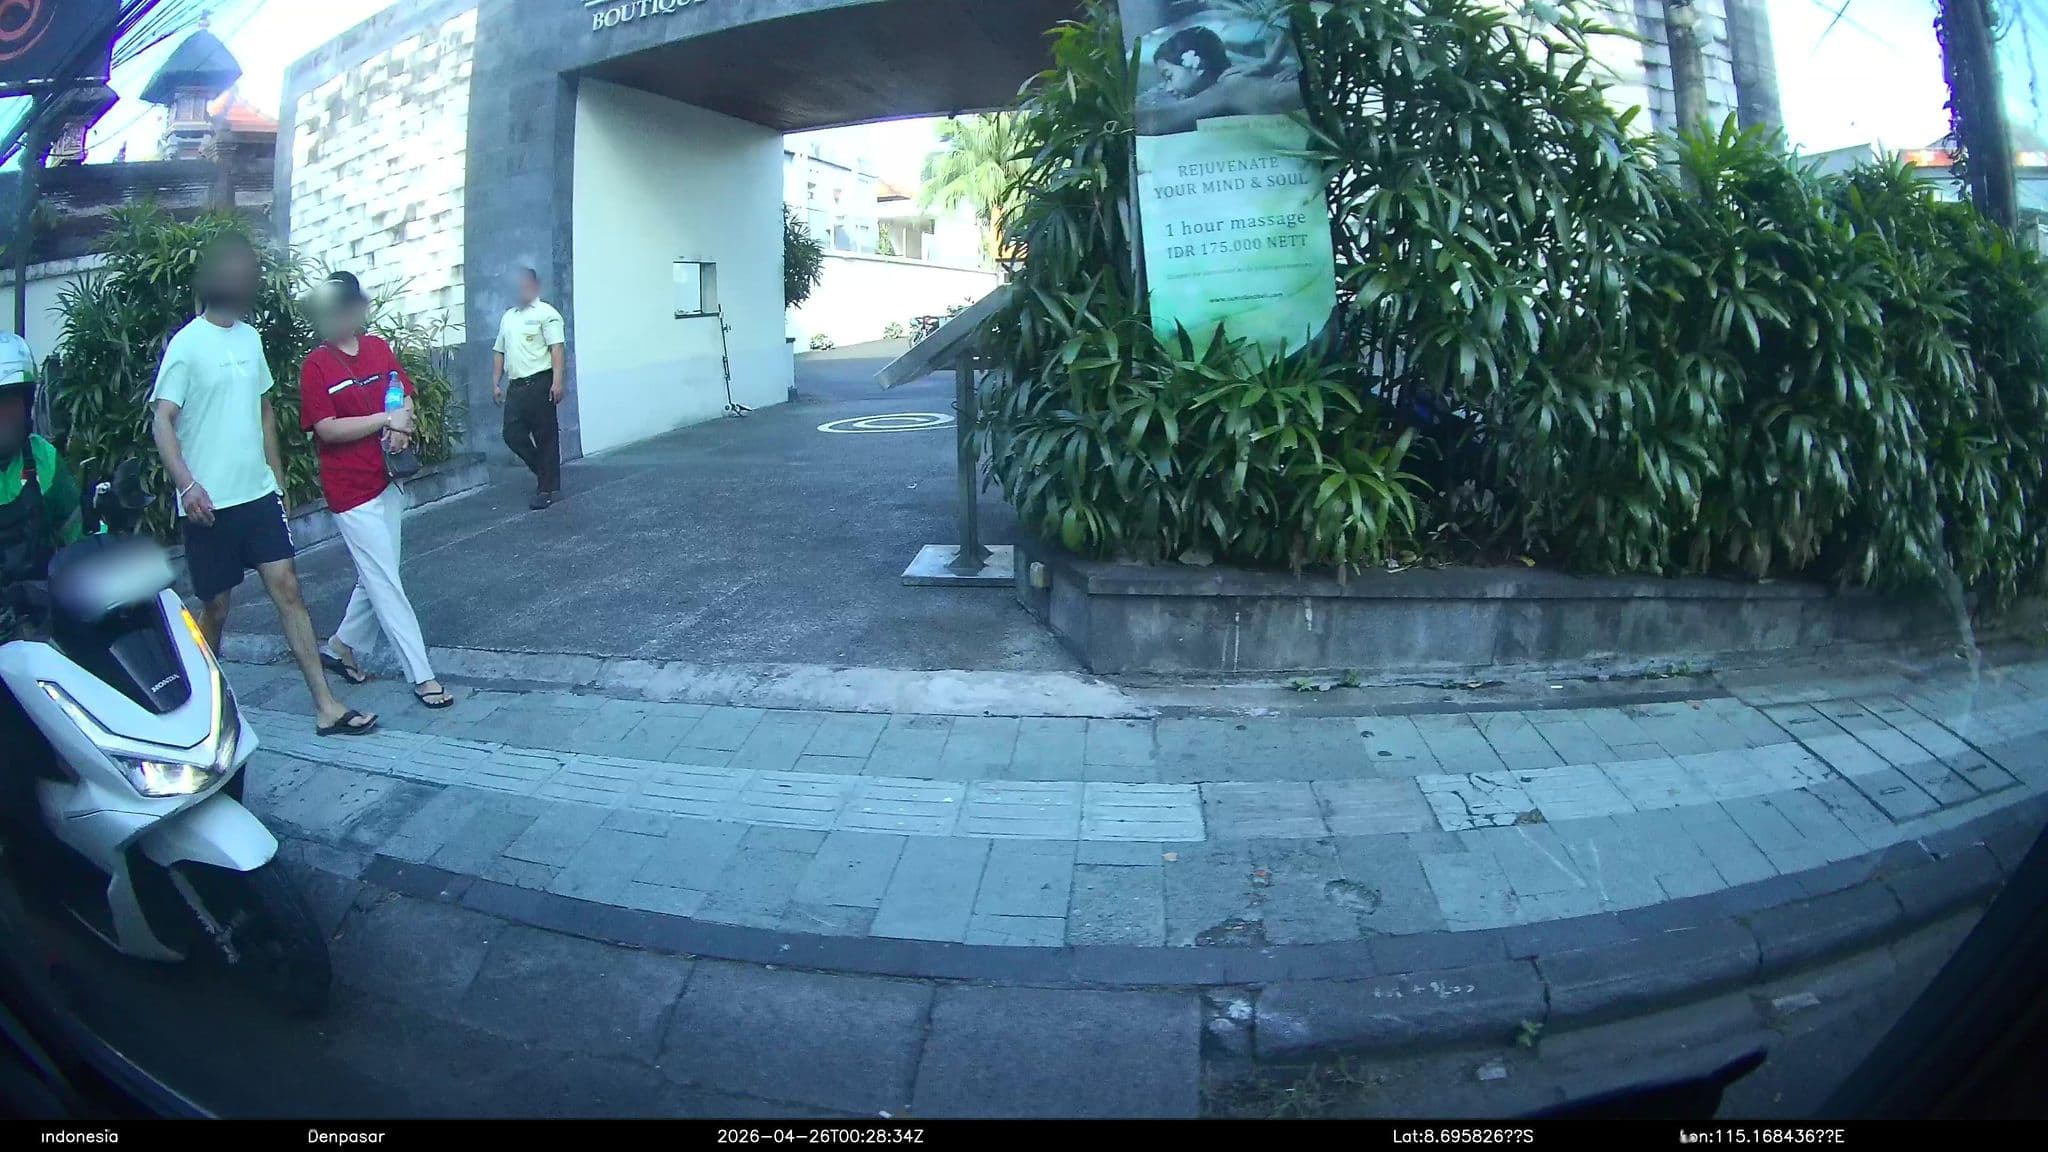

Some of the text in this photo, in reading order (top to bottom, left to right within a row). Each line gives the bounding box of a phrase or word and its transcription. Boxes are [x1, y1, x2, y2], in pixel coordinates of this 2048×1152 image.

[592, 0, 707, 31] BOUTIQ
[1178, 156, 1280, 178] REJUVENATE
[1153, 171, 1309, 200] YOUR MIND & SOUL
[1166, 211, 1307, 237] 1 hour massage
[1167, 233, 1309, 260] IDR 175.000 NETT
[150, 673, 180, 693] HONDA
